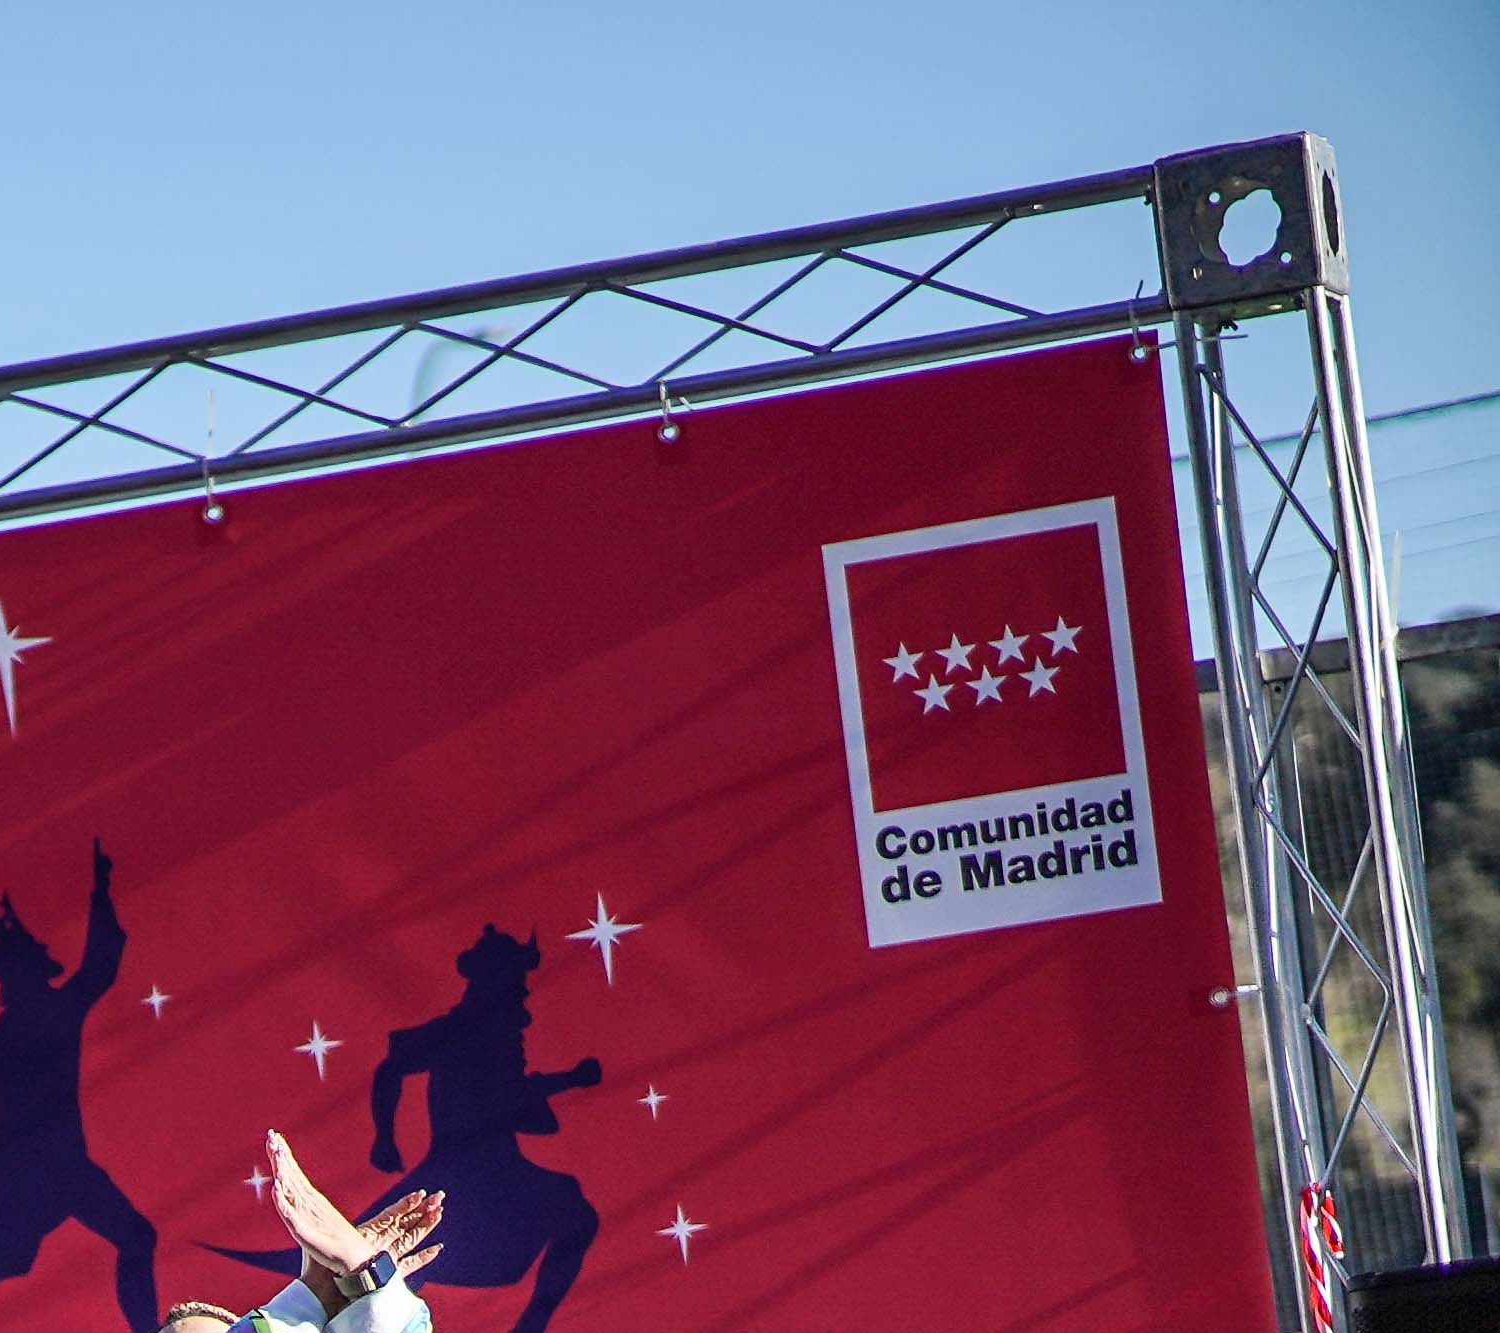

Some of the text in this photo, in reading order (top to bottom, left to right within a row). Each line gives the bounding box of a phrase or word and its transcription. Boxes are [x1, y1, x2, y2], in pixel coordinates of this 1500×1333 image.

[875, 788, 1135, 860] Comunidad
[881, 828, 1139, 904] de Madrid
